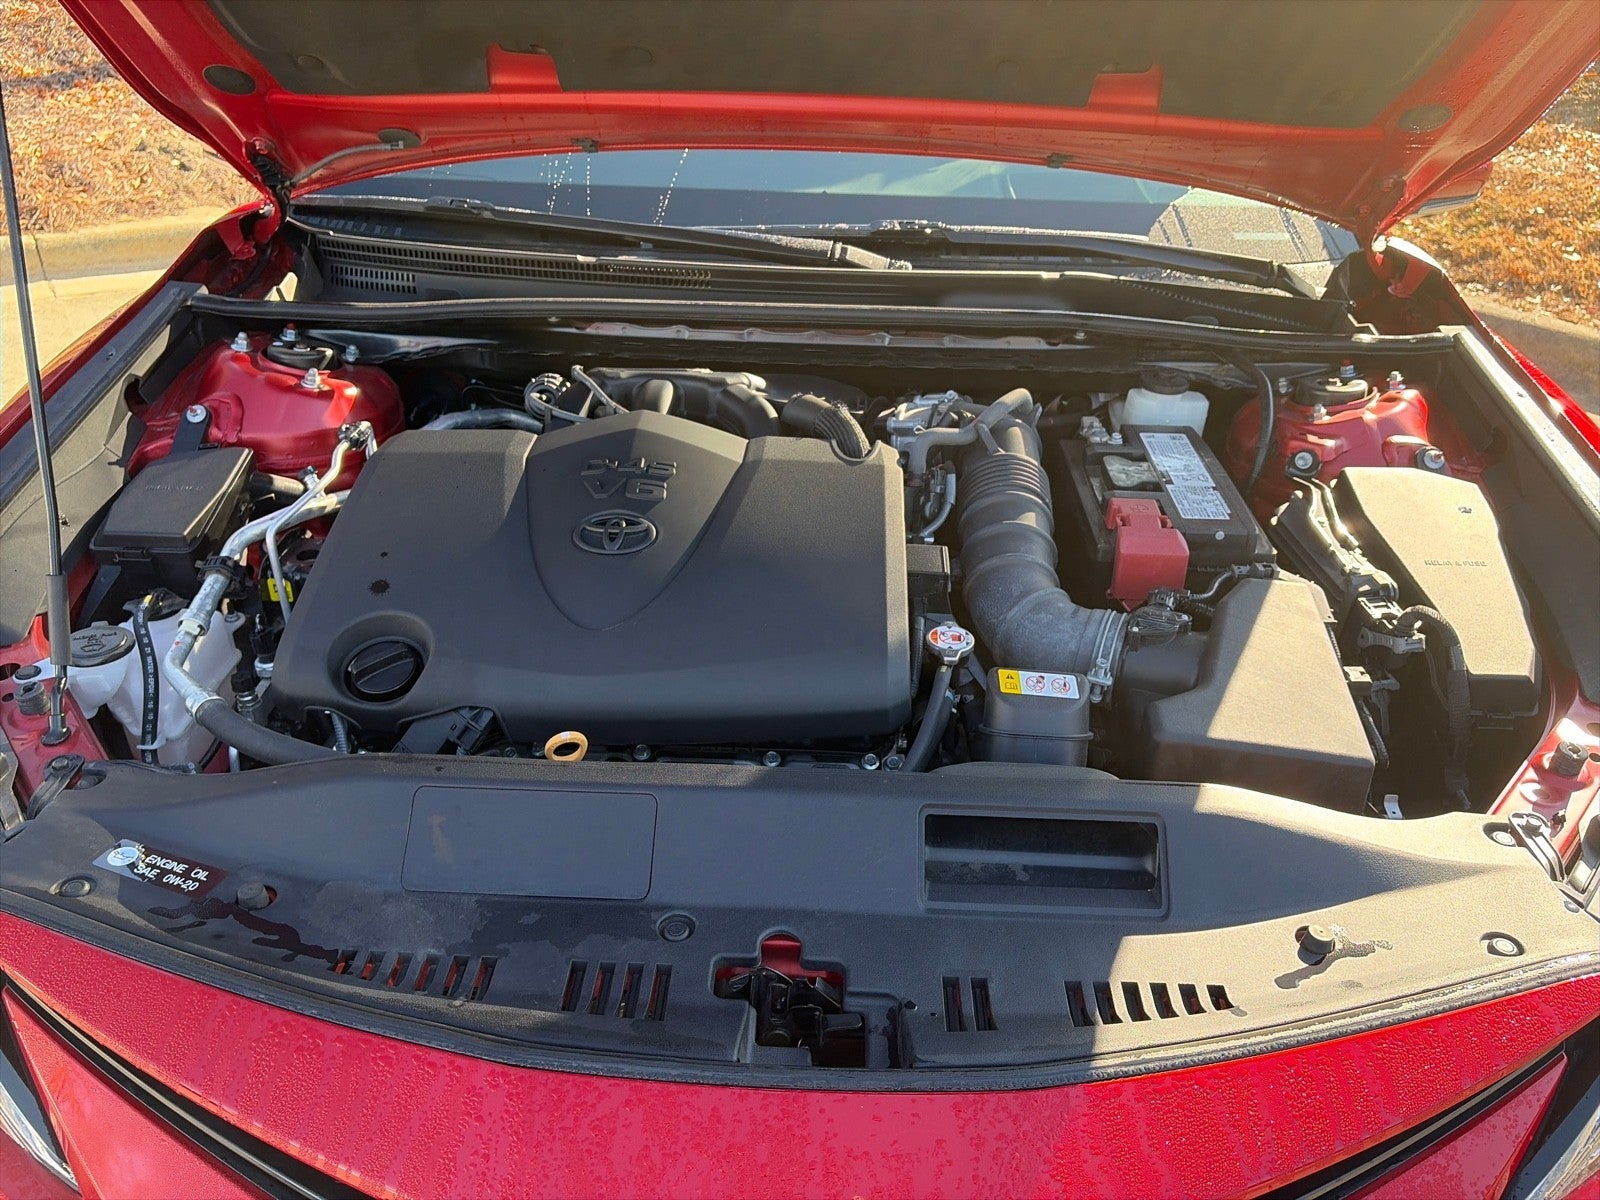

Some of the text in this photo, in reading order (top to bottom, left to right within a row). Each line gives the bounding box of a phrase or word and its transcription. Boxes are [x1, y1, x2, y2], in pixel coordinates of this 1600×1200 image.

[583, 478, 667, 500] V6
[133, 864, 200, 892] SAE 0W-20
[145, 854, 209, 881] ENGINE OIL
